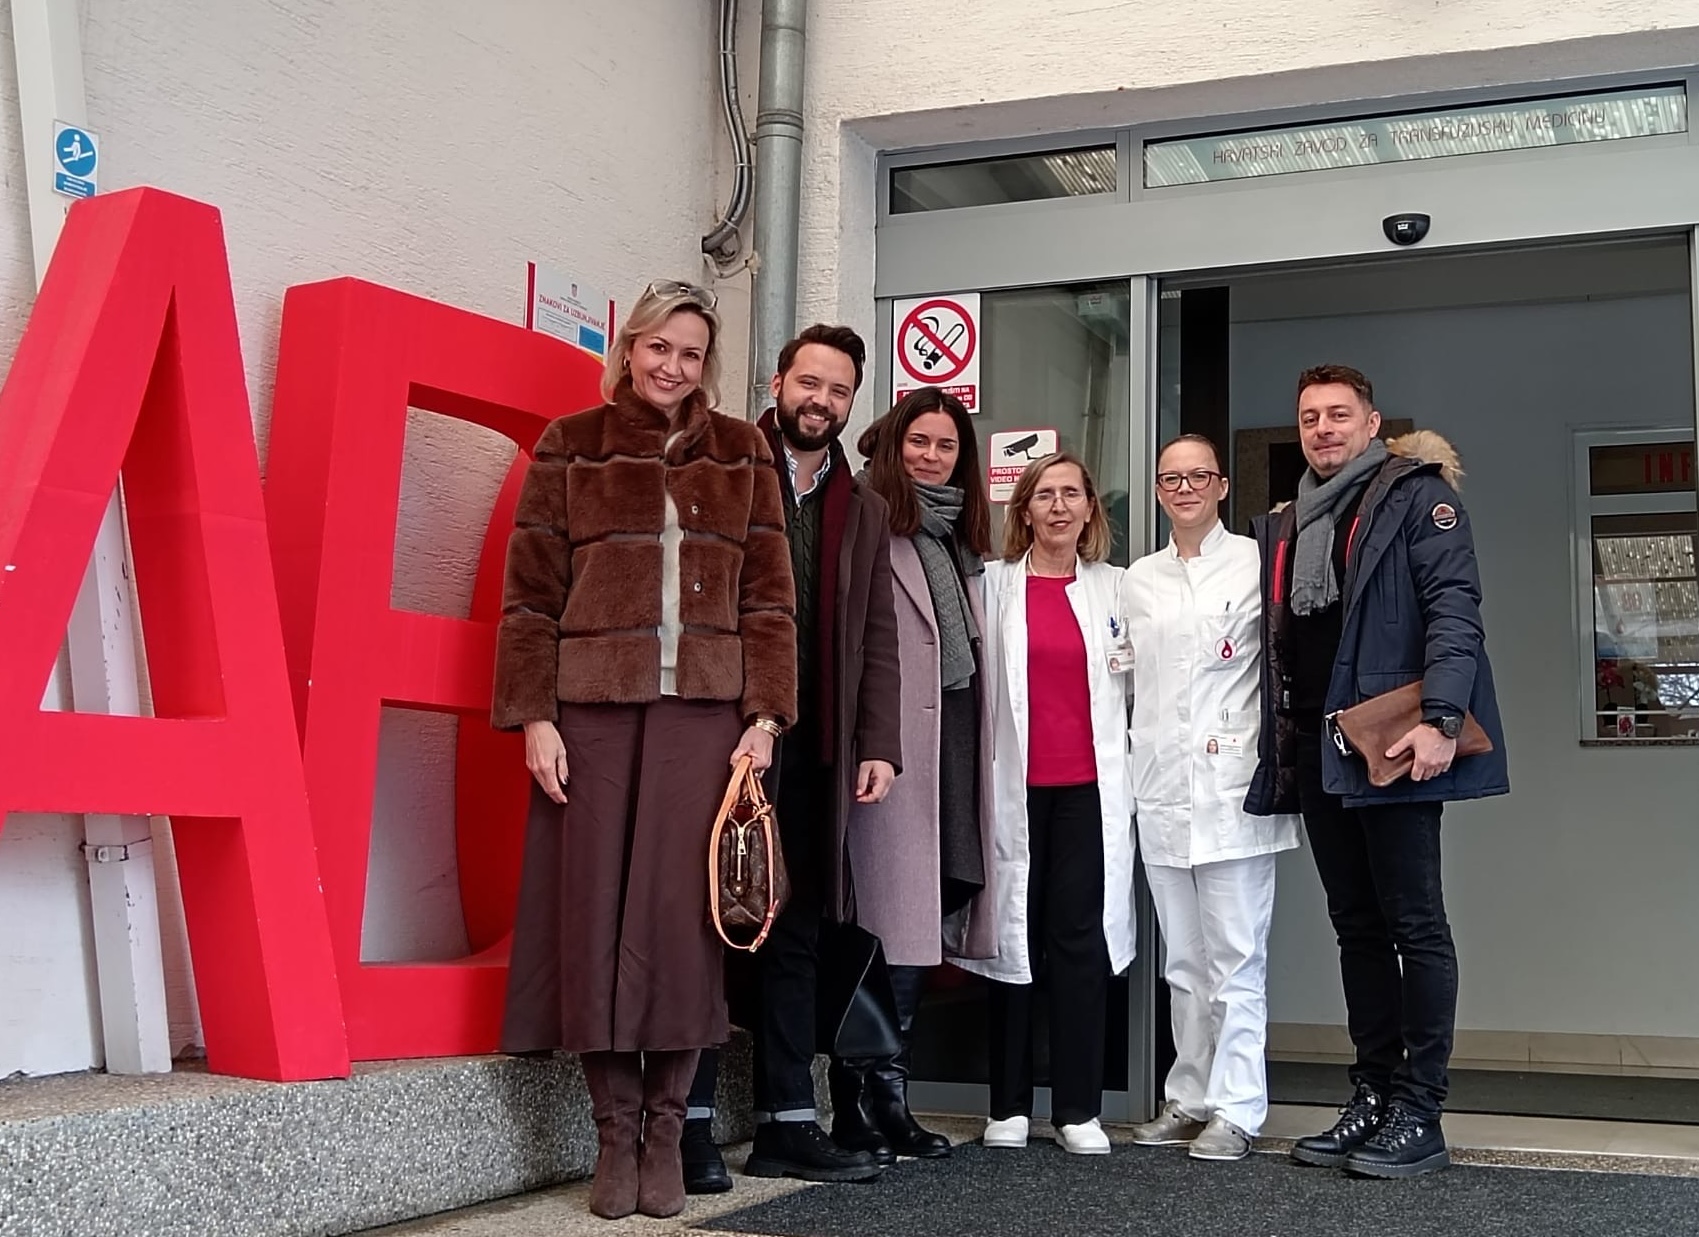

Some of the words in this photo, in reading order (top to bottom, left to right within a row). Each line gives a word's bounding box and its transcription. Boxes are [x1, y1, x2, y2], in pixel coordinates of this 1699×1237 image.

[1213, 144, 1283, 164] HRVATSKI
[1294, 136, 1347, 156] ZAVOD
[1359, 133, 1378, 149] ZA
[1389, 118, 1514, 145] TRANSFUZIJSKU
[1525, 108, 1606, 130] MEDICINU
[539, 294, 562, 311] ZNAKOVI
[990, 475, 1013, 483] VIDEO
